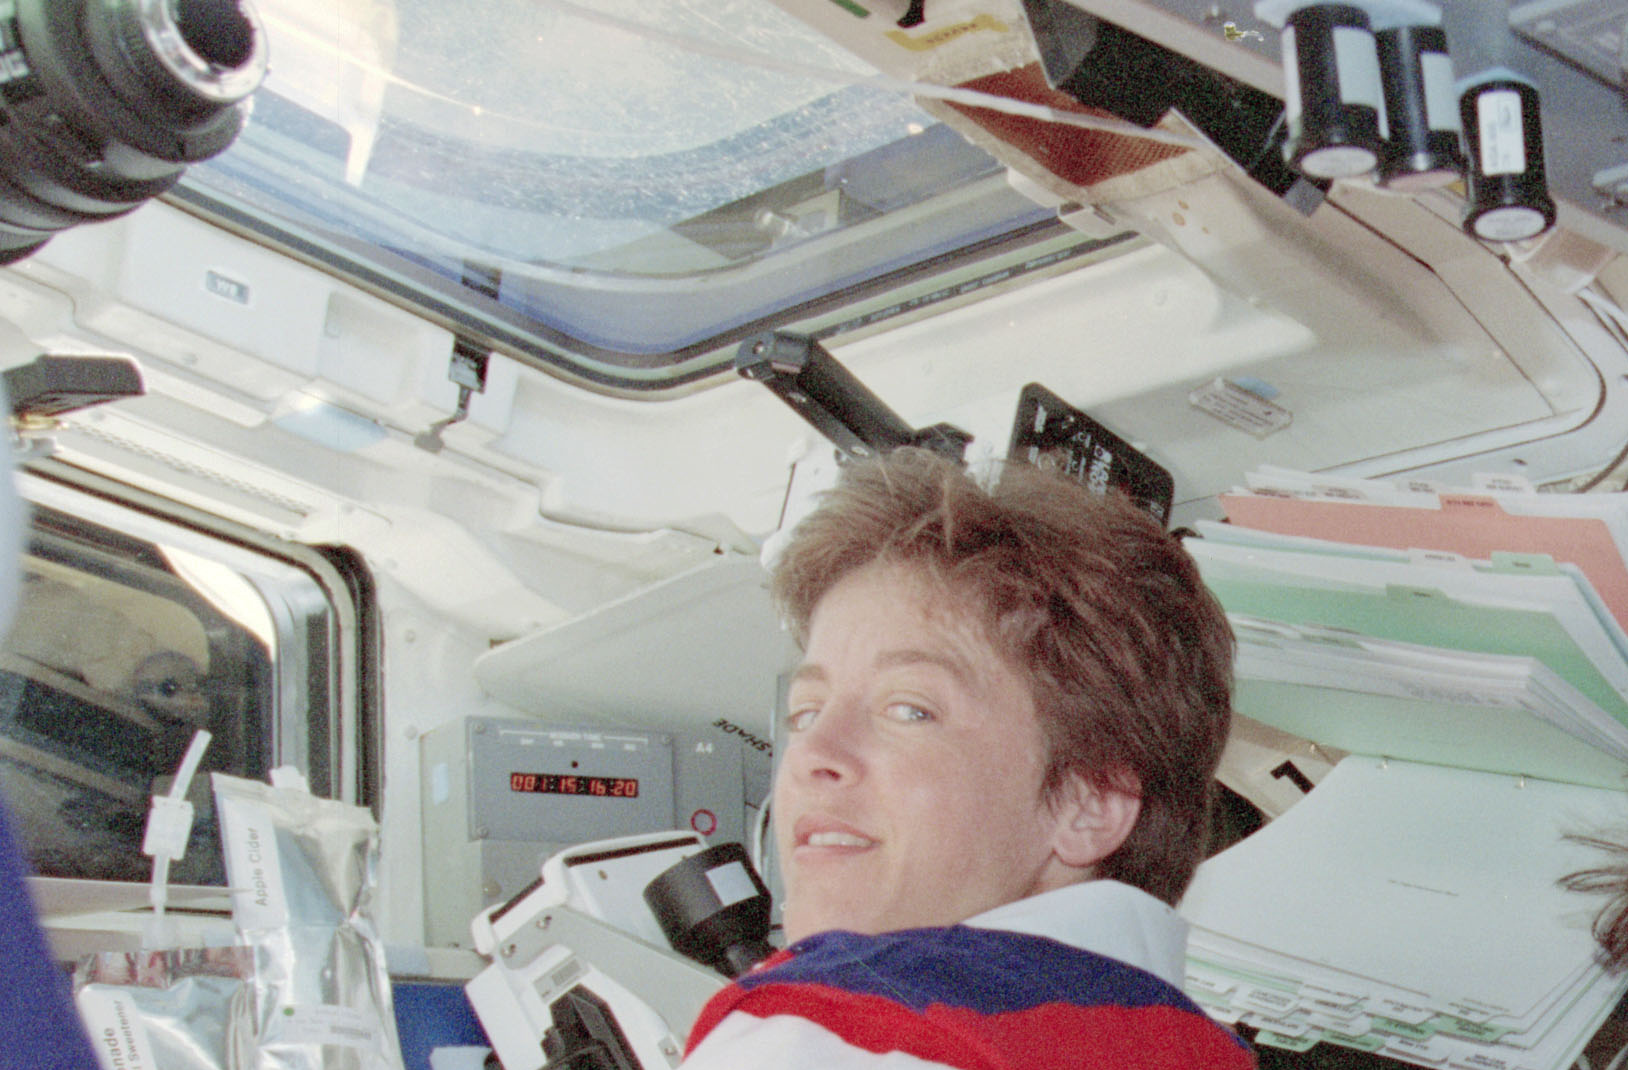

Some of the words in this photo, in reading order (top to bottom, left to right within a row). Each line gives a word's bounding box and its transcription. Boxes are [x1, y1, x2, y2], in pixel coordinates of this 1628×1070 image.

[247, 826, 262, 864] Cider
[251, 868, 270, 907] Apple
[113, 1000, 141, 1062] Sweetener
